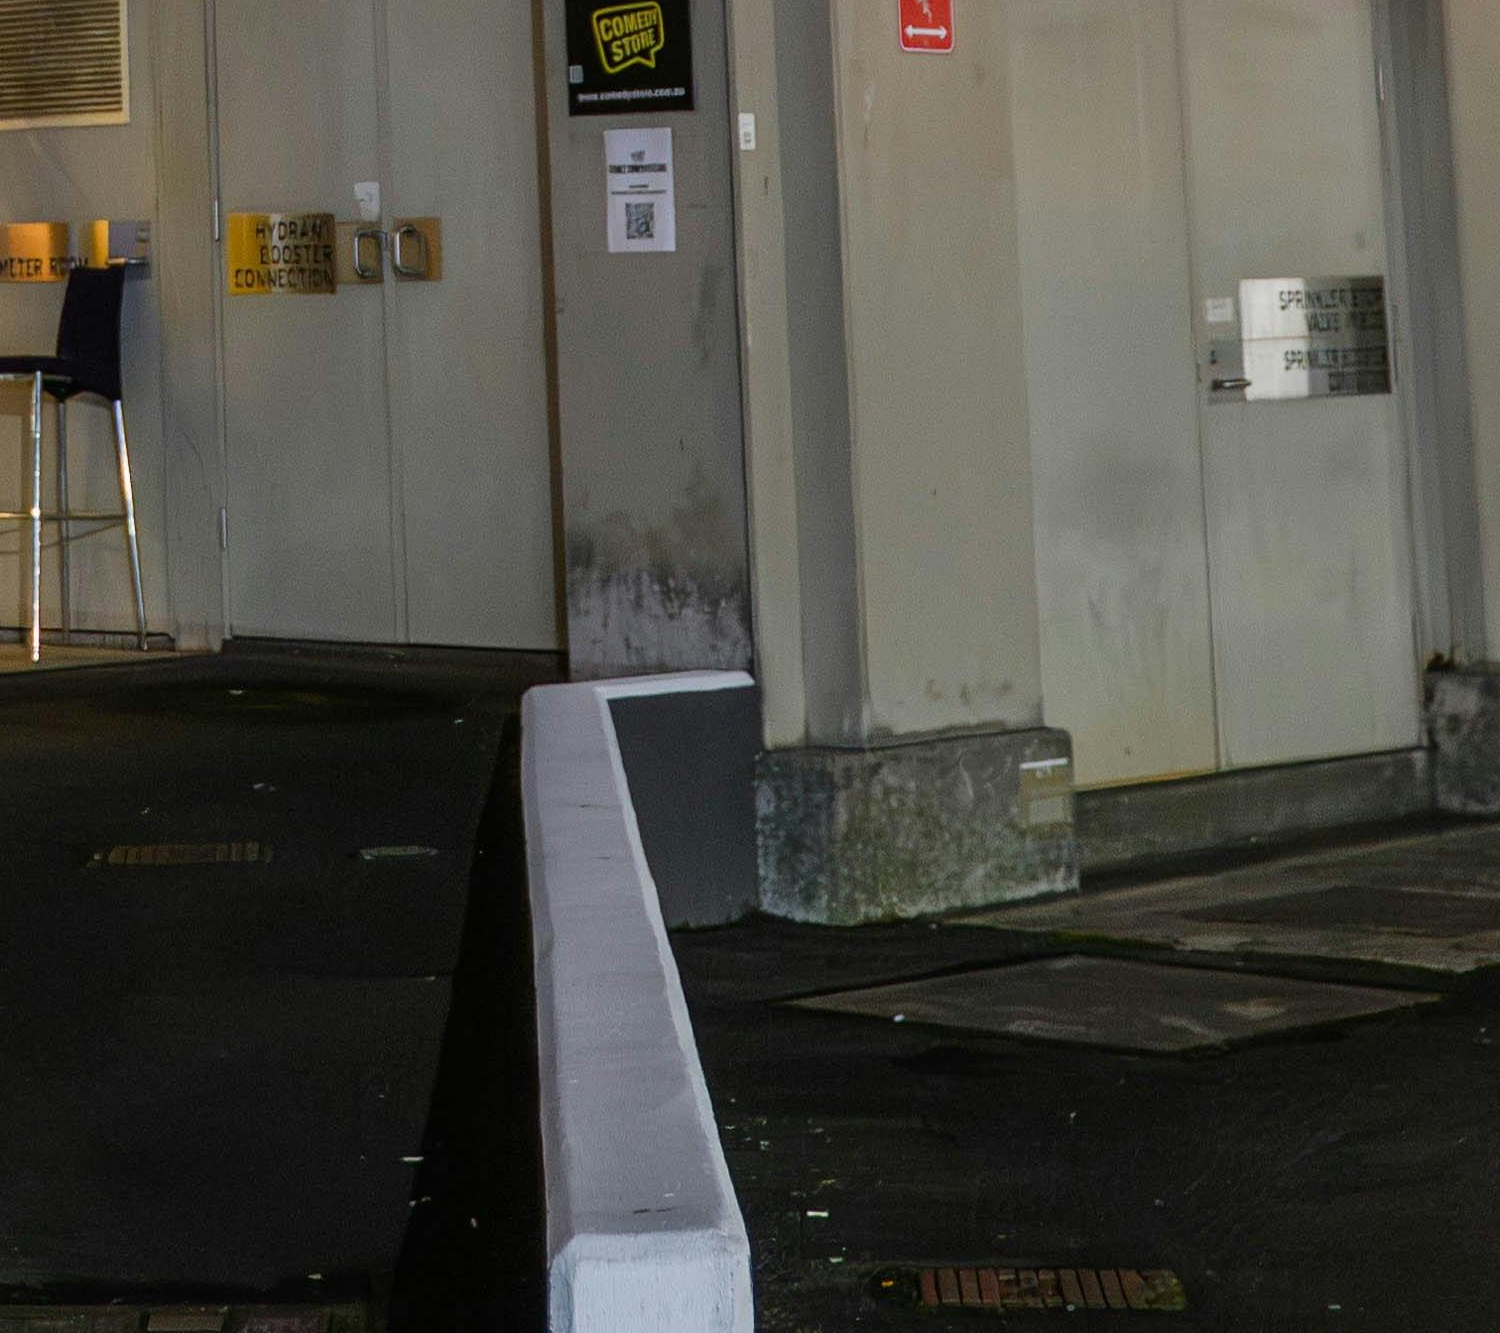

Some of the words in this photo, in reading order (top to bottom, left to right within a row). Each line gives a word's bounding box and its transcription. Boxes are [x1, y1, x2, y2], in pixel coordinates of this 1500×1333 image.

[600, 8, 658, 40] COMEDY
[611, 29, 656, 62] STORE
[234, 268, 335, 289] CONNECTION
